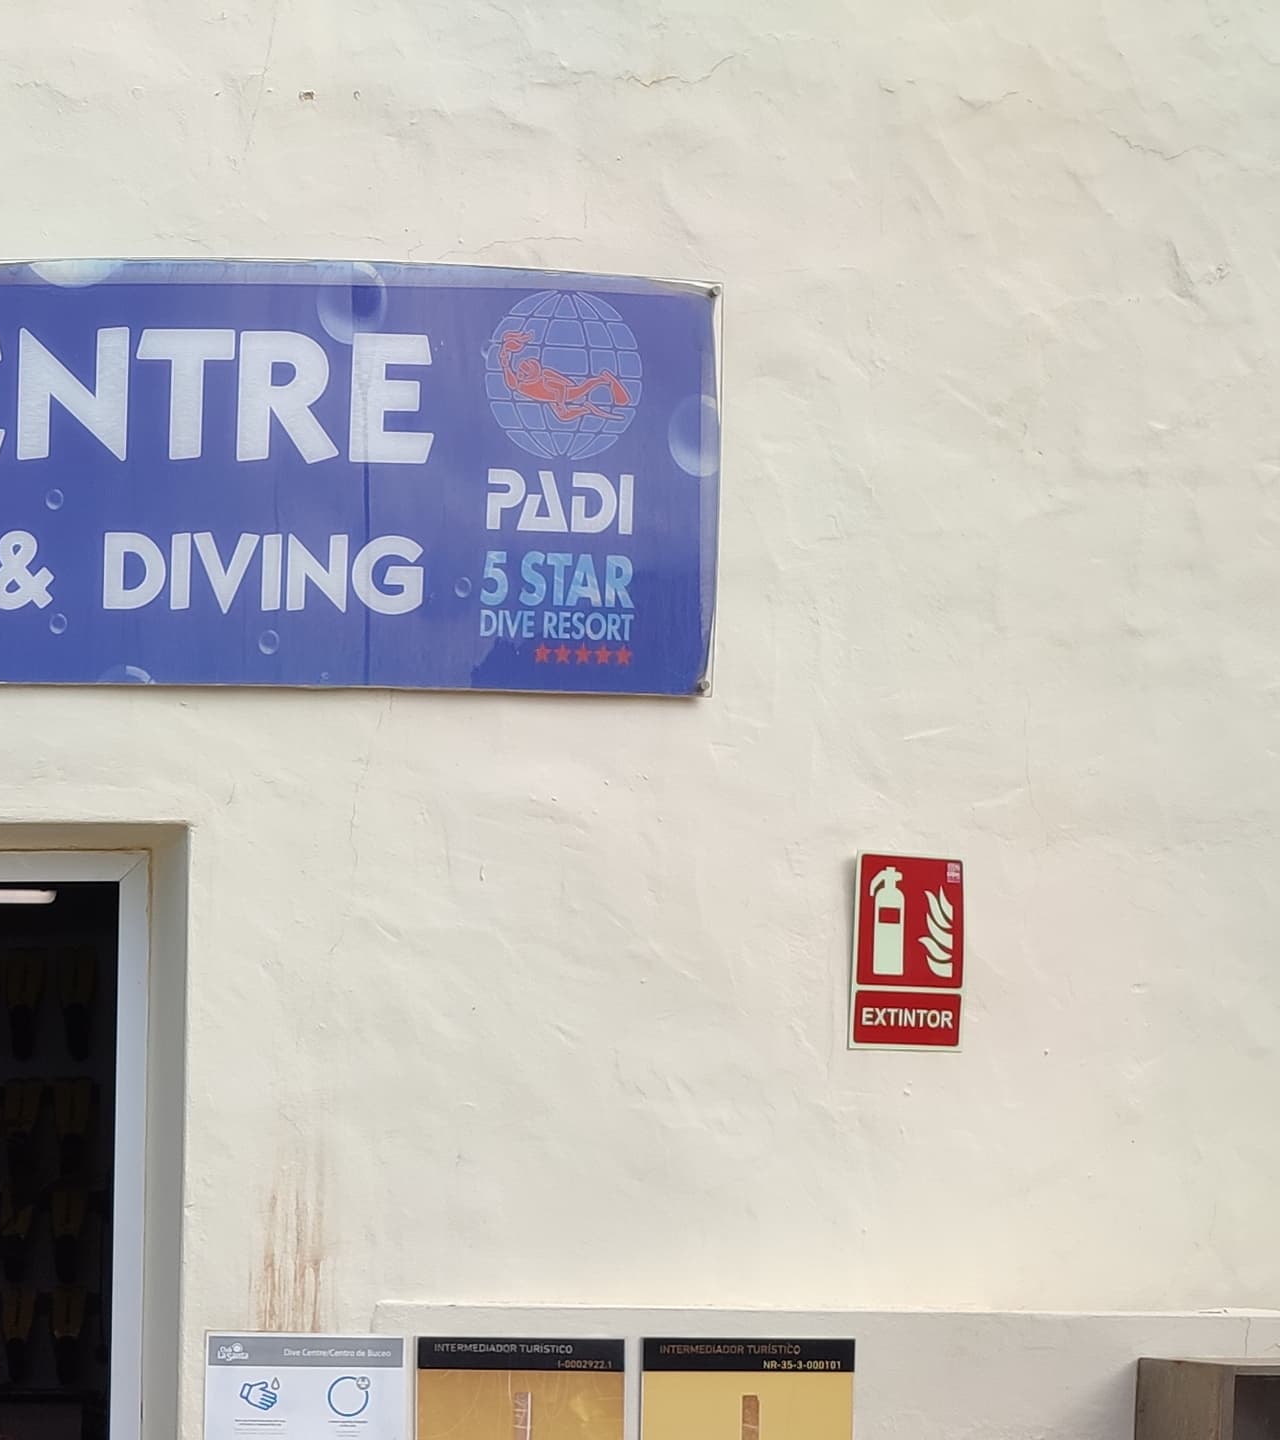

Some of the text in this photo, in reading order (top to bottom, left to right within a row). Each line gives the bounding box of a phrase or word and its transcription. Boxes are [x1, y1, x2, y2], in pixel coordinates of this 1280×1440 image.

[486, 468, 635, 535] PADI
[102, 532, 425, 614] DIVING
[480, 550, 635, 609] 5 STAR
[479, 609, 635, 641] DIVE RESORT
[861, 1007, 953, 1029] EXTINTOR
[434, 1343, 517, 1353] INTERMEDIADOR
[659, 1344, 744, 1355] INTERMEDIADOR
